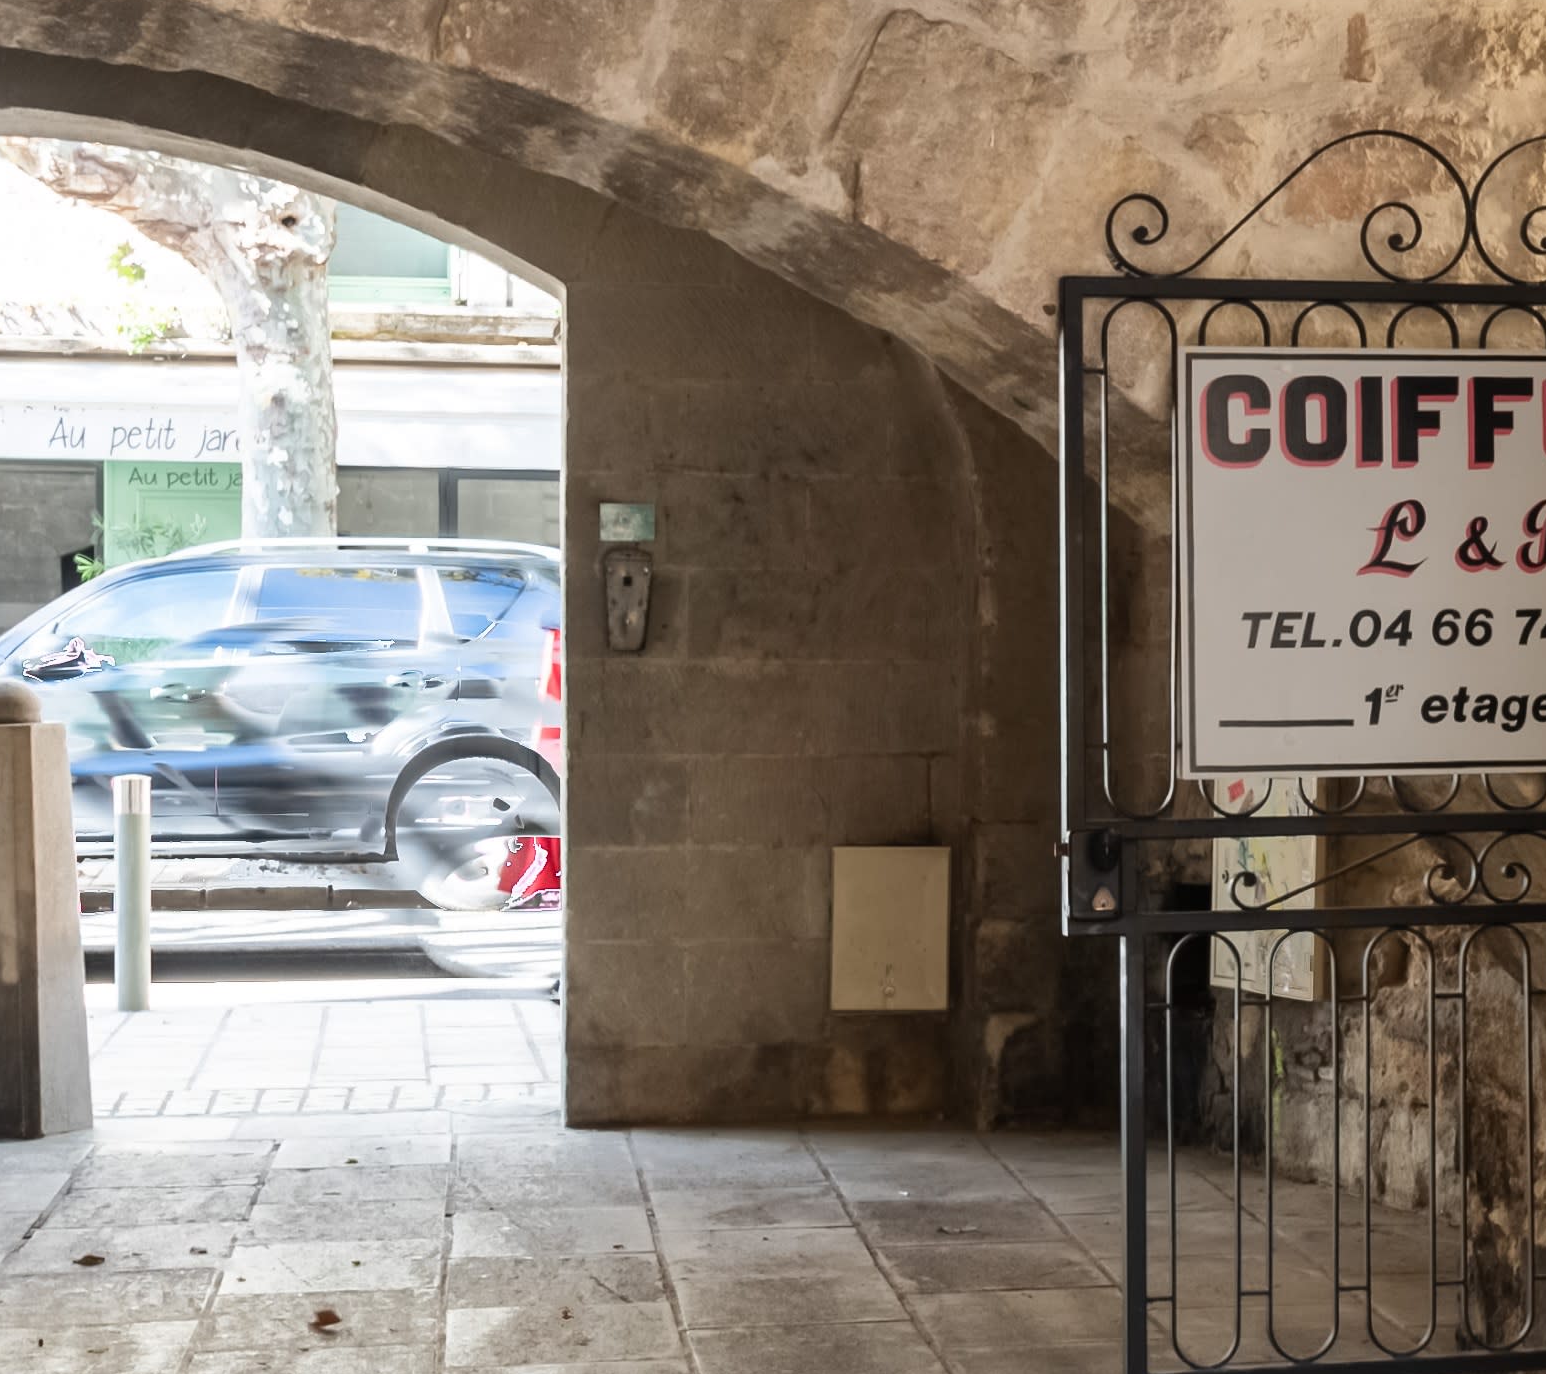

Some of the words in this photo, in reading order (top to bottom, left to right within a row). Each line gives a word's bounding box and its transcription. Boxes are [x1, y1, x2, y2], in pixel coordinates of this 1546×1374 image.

[49, 417, 86, 450] Au
[110, 418, 175, 457] petit
[194, 427, 240, 459] jar
[128, 467, 156, 486] Au
[166, 467, 219, 489] petit
[225, 469, 243, 491] ja
[1356, 499, 1428, 578] L
[1454, 516, 1507, 573] &
[1432, 608, 1494, 647] 66
